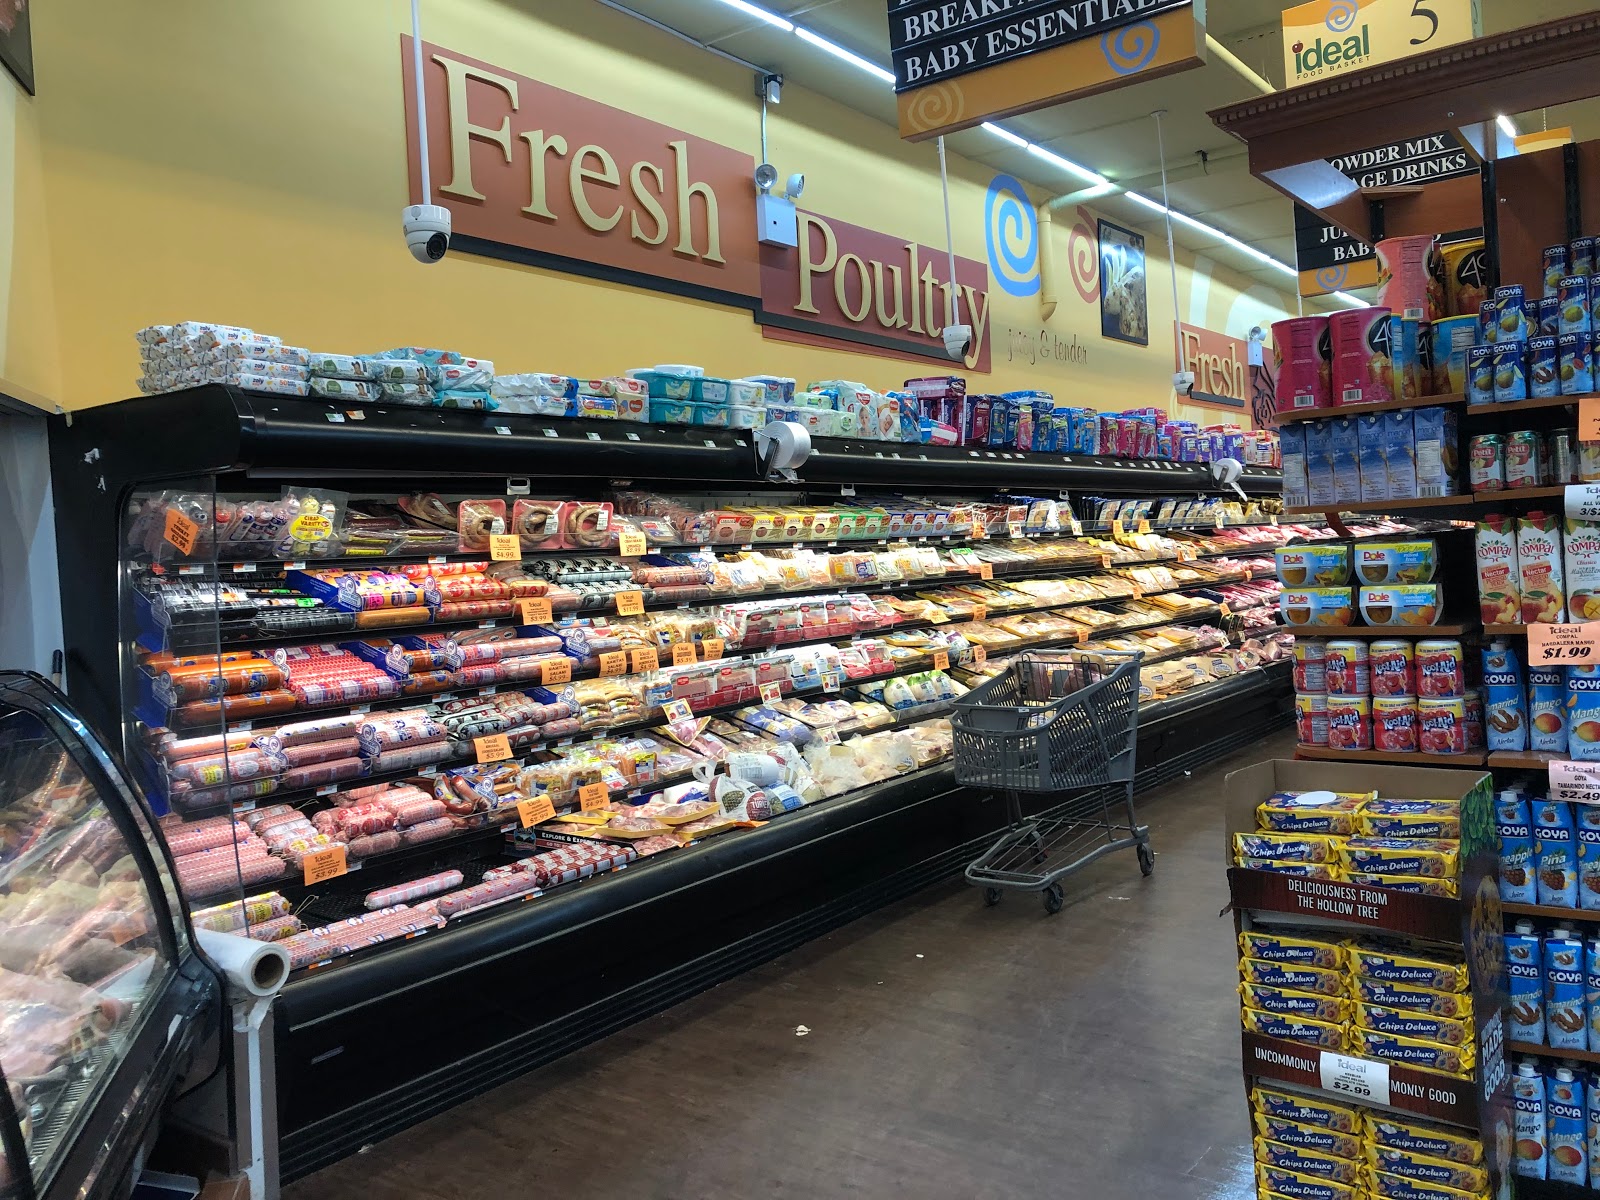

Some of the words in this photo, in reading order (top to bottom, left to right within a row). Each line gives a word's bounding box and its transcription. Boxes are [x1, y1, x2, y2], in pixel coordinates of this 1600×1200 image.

[903, 0, 1032, 42] BREAK
[1409, 0, 1439, 46] 5
[1291, 24, 1370, 75] ideal
[905, 36, 979, 82] BABY
[1297, 67, 1323, 80] FOOD
[1329, 55, 1370, 72] BASKET
[430, 53, 727, 264] Fresh
[1331, 145, 1400, 172] OWDER
[1405, 134, 1446, 158] MIX
[1353, 165, 1388, 188] AGE
[1392, 153, 1467, 183] DRINKS
[1571, 240, 1592, 248] GOYA
[1333, 244, 1376, 262] BAB
[1545, 247, 1565, 256] GOYA
[1560, 277, 1584, 287] GOYA
[1591, 276, 1600, 285] GO
[793, 210, 990, 369] Poultry
[1499, 288, 1522, 297] GOYA
[1484, 303, 1495, 311] GO
[1501, 305, 1520, 317] Pear
[1531, 339, 1555, 349] GOYA
[1559, 335, 1576, 344] OYA
[1040, 330, 1051, 357] &
[1053, 334, 1088, 365] tender
[1494, 343, 1517, 353] GOYA
[1183, 328, 1246, 401] Fresh
[1496, 361, 1515, 372] Pear
[1476, 366, 1492, 376] Pea
[171, 534, 186, 548] $2.99
[1284, 555, 1303, 564] Dole
[1364, 551, 1385, 561] Dole
[1484, 568, 1504, 578] Nectar
[1526, 567, 1547, 576] Nectar
[1288, 594, 1308, 604] Dole
[1369, 592, 1389, 602] Dole
[1542, 647, 1591, 659] $1.99
[1375, 657, 1406, 675] Kool-Aid
[1422, 657, 1456, 675] Kool-Aid
[1485, 674, 1516, 684] GOYA
[1529, 673, 1561, 683] GOYA
[1530, 698, 1562, 711] Mango
[1571, 708, 1600, 720] Mang
[1383, 713, 1416, 730] Kool-Aid
[1422, 713, 1454, 730] Kool-Aid
[1559, 790, 1600, 800] $2.49
[1281, 822, 1302, 830] Chips
[1302, 820, 1328, 829] Deluxe
[541, 832, 566, 841] EXPLORE
[1385, 829, 1409, 838] Chips
[1410, 825, 1439, 836] Deluxe
[1496, 826, 1528, 836] GOYA
[1535, 828, 1569, 839] GOYA
[1501, 847, 1532, 863] neapple
[1541, 853, 1566, 866] Piña
[1364, 864, 1388, 873] Chips
[1389, 860, 1419, 870] Deluxe
[315, 868, 337, 879] $3.99
[1288, 879, 1357, 901] DELICIOUSNESS
[1360, 890, 1388, 906] FROM
[1298, 895, 1314, 908] THE
[1317, 898, 1354, 916] HOLLOW
[1357, 904, 1379, 919] TREE
[1263, 950, 1285, 959] Chips
[1375, 969, 1400, 979] Chips
[1401, 969, 1433, 979] Deluxe
[1506, 965, 1538, 976] GOYA
[1549, 971, 1582, 981] GOYA
[1264, 974, 1286, 984] Chips
[1589, 977, 1600, 986] GO
[1265, 1000, 1287, 1009] Chips
[1373, 994, 1399, 1003] Chips
[1399, 995, 1431, 1004] Deluxe
[1378, 1022, 1404, 1031] Chips
[1405, 1022, 1437, 1031] Deluxe
[1482, 1022, 1503, 1066] MADE
[1377, 1048, 1403, 1058] Chips
[1403, 1049, 1435, 1059] Deluxe
[1338, 1059, 1366, 1073] ideal
[1255, 1047, 1317, 1073] UNCOMMONLY
[1390, 1079, 1425, 1098] MONLY
[1429, 1089, 1456, 1105] GOOD
[1485, 1059, 1505, 1101] GOOD
[1333, 1081, 1371, 1096] $2.99
[1516, 1101, 1541, 1112] OYA
[1548, 1104, 1581, 1117] GOYA
[1276, 1109, 1299, 1117] Chips
[1280, 1133, 1302, 1143] Chips
[1304, 1135, 1333, 1145] Deluxe
[1550, 1132, 1582, 1142] Mango
[1389, 1138, 1415, 1147] Chips
[1415, 1139, 1447, 1150] Deluxe
[1279, 1159, 1302, 1168] Chips
[1303, 1160, 1332, 1170] Deluxe
[1392, 1165, 1417, 1175] Chips
[1418, 1167, 1450, 1178] Deluxe
[1279, 1185, 1302, 1194] Chips
[1303, 1186, 1331, 1197] Deluxe
